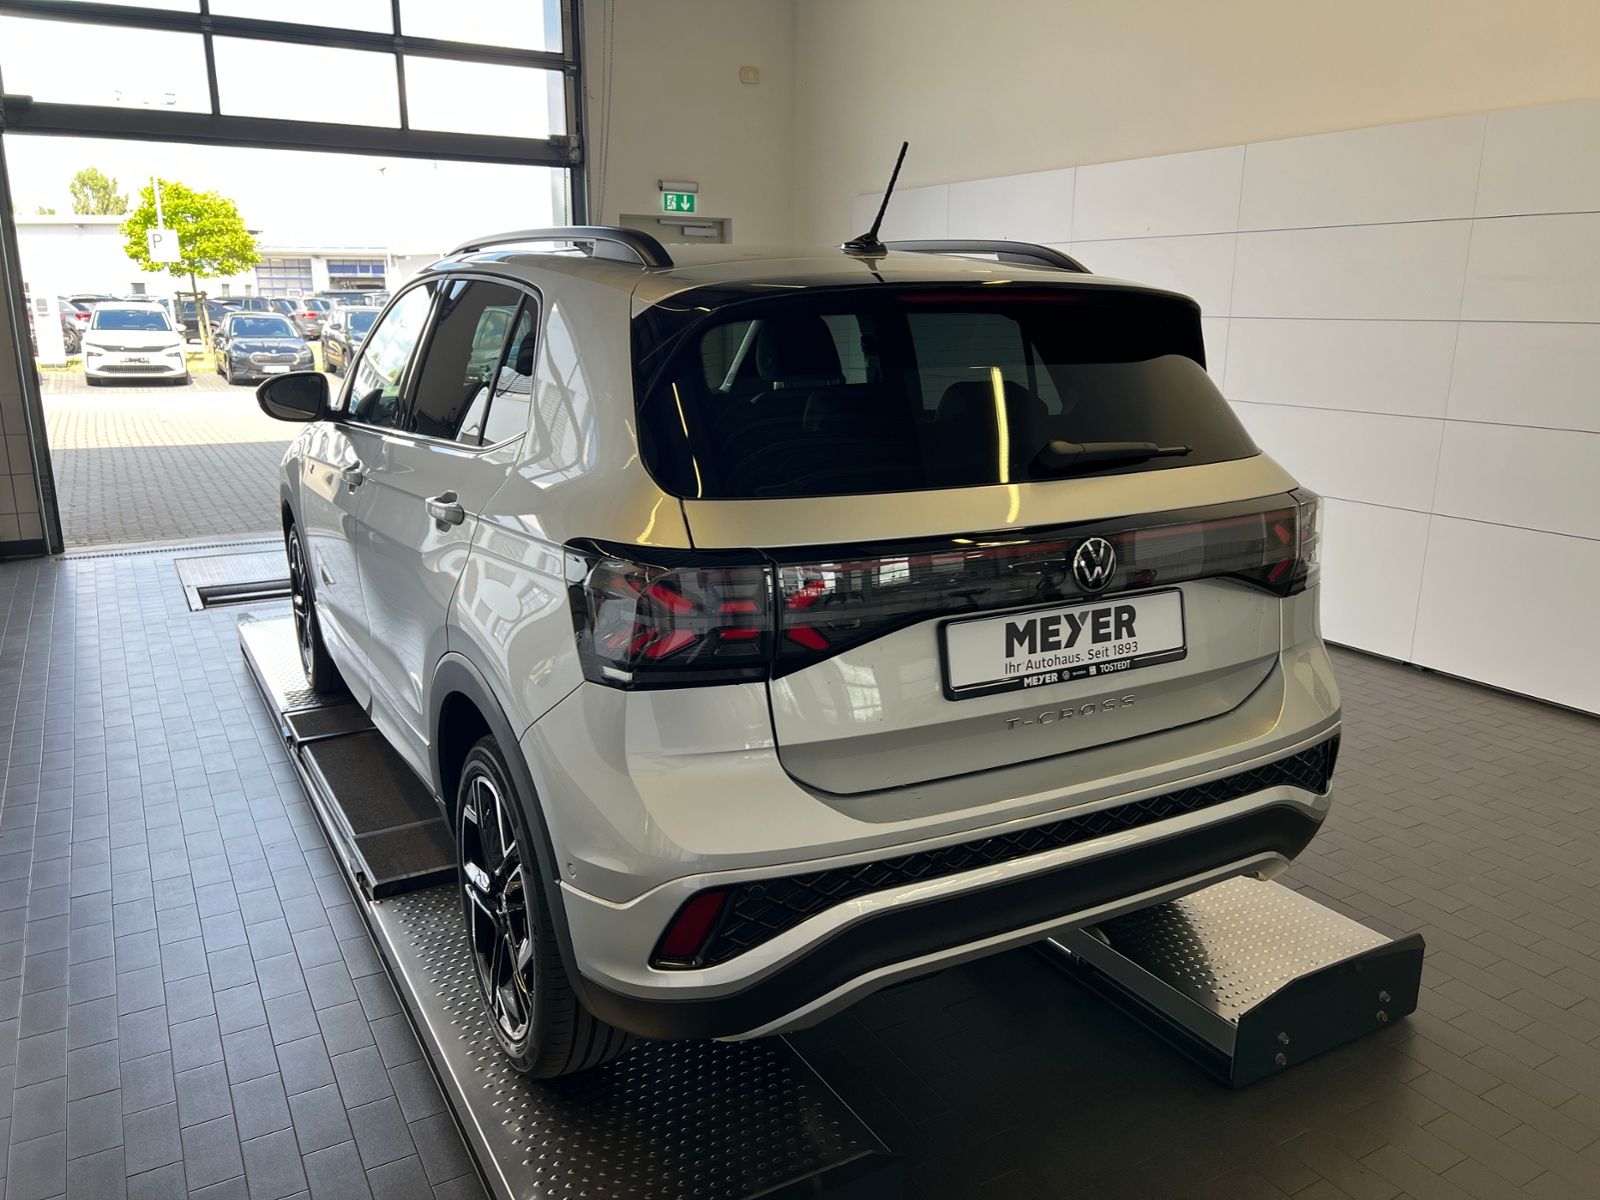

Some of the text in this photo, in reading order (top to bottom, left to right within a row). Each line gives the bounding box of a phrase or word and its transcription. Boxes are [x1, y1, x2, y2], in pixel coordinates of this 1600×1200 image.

[152, 233, 163, 249] P
[1005, 604, 1137, 659] MEYER
[1004, 641, 1139, 675] Ihr Autohaus. Seit 1893
[1023, 672, 1059, 688] MEYER
[1099, 660, 1131, 674] TOSTEDT
[1004, 694, 1136, 732] T-CROSS
